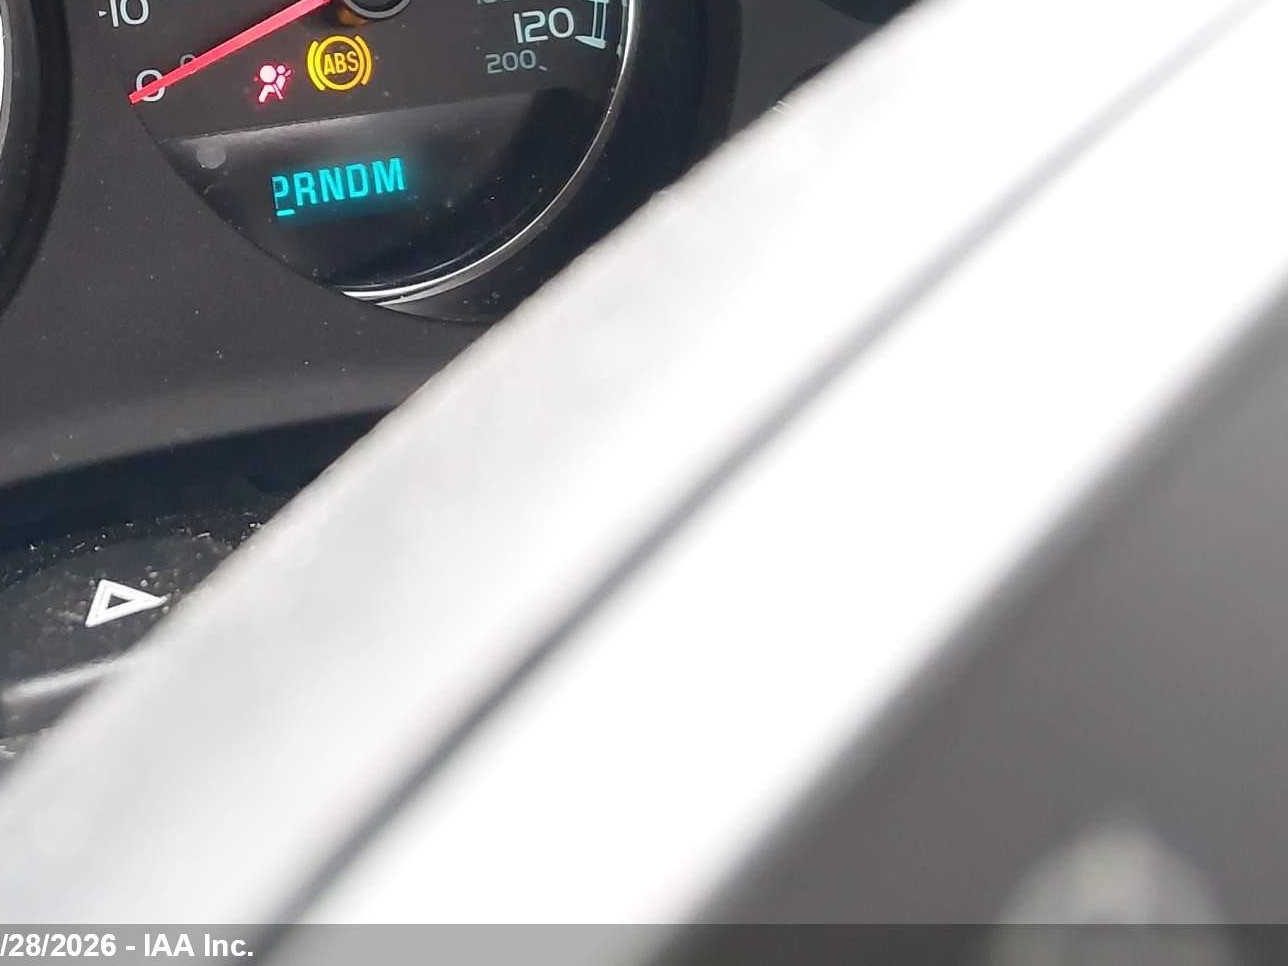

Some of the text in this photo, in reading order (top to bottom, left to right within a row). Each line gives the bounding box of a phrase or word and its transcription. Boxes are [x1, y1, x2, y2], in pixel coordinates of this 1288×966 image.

[513, 7, 575, 43] 120
[323, 50, 360, 75] ABS
[485, 49, 536, 74] 200
[136, 69, 165, 102] 0
[272, 156, 405, 209] PRNDM
